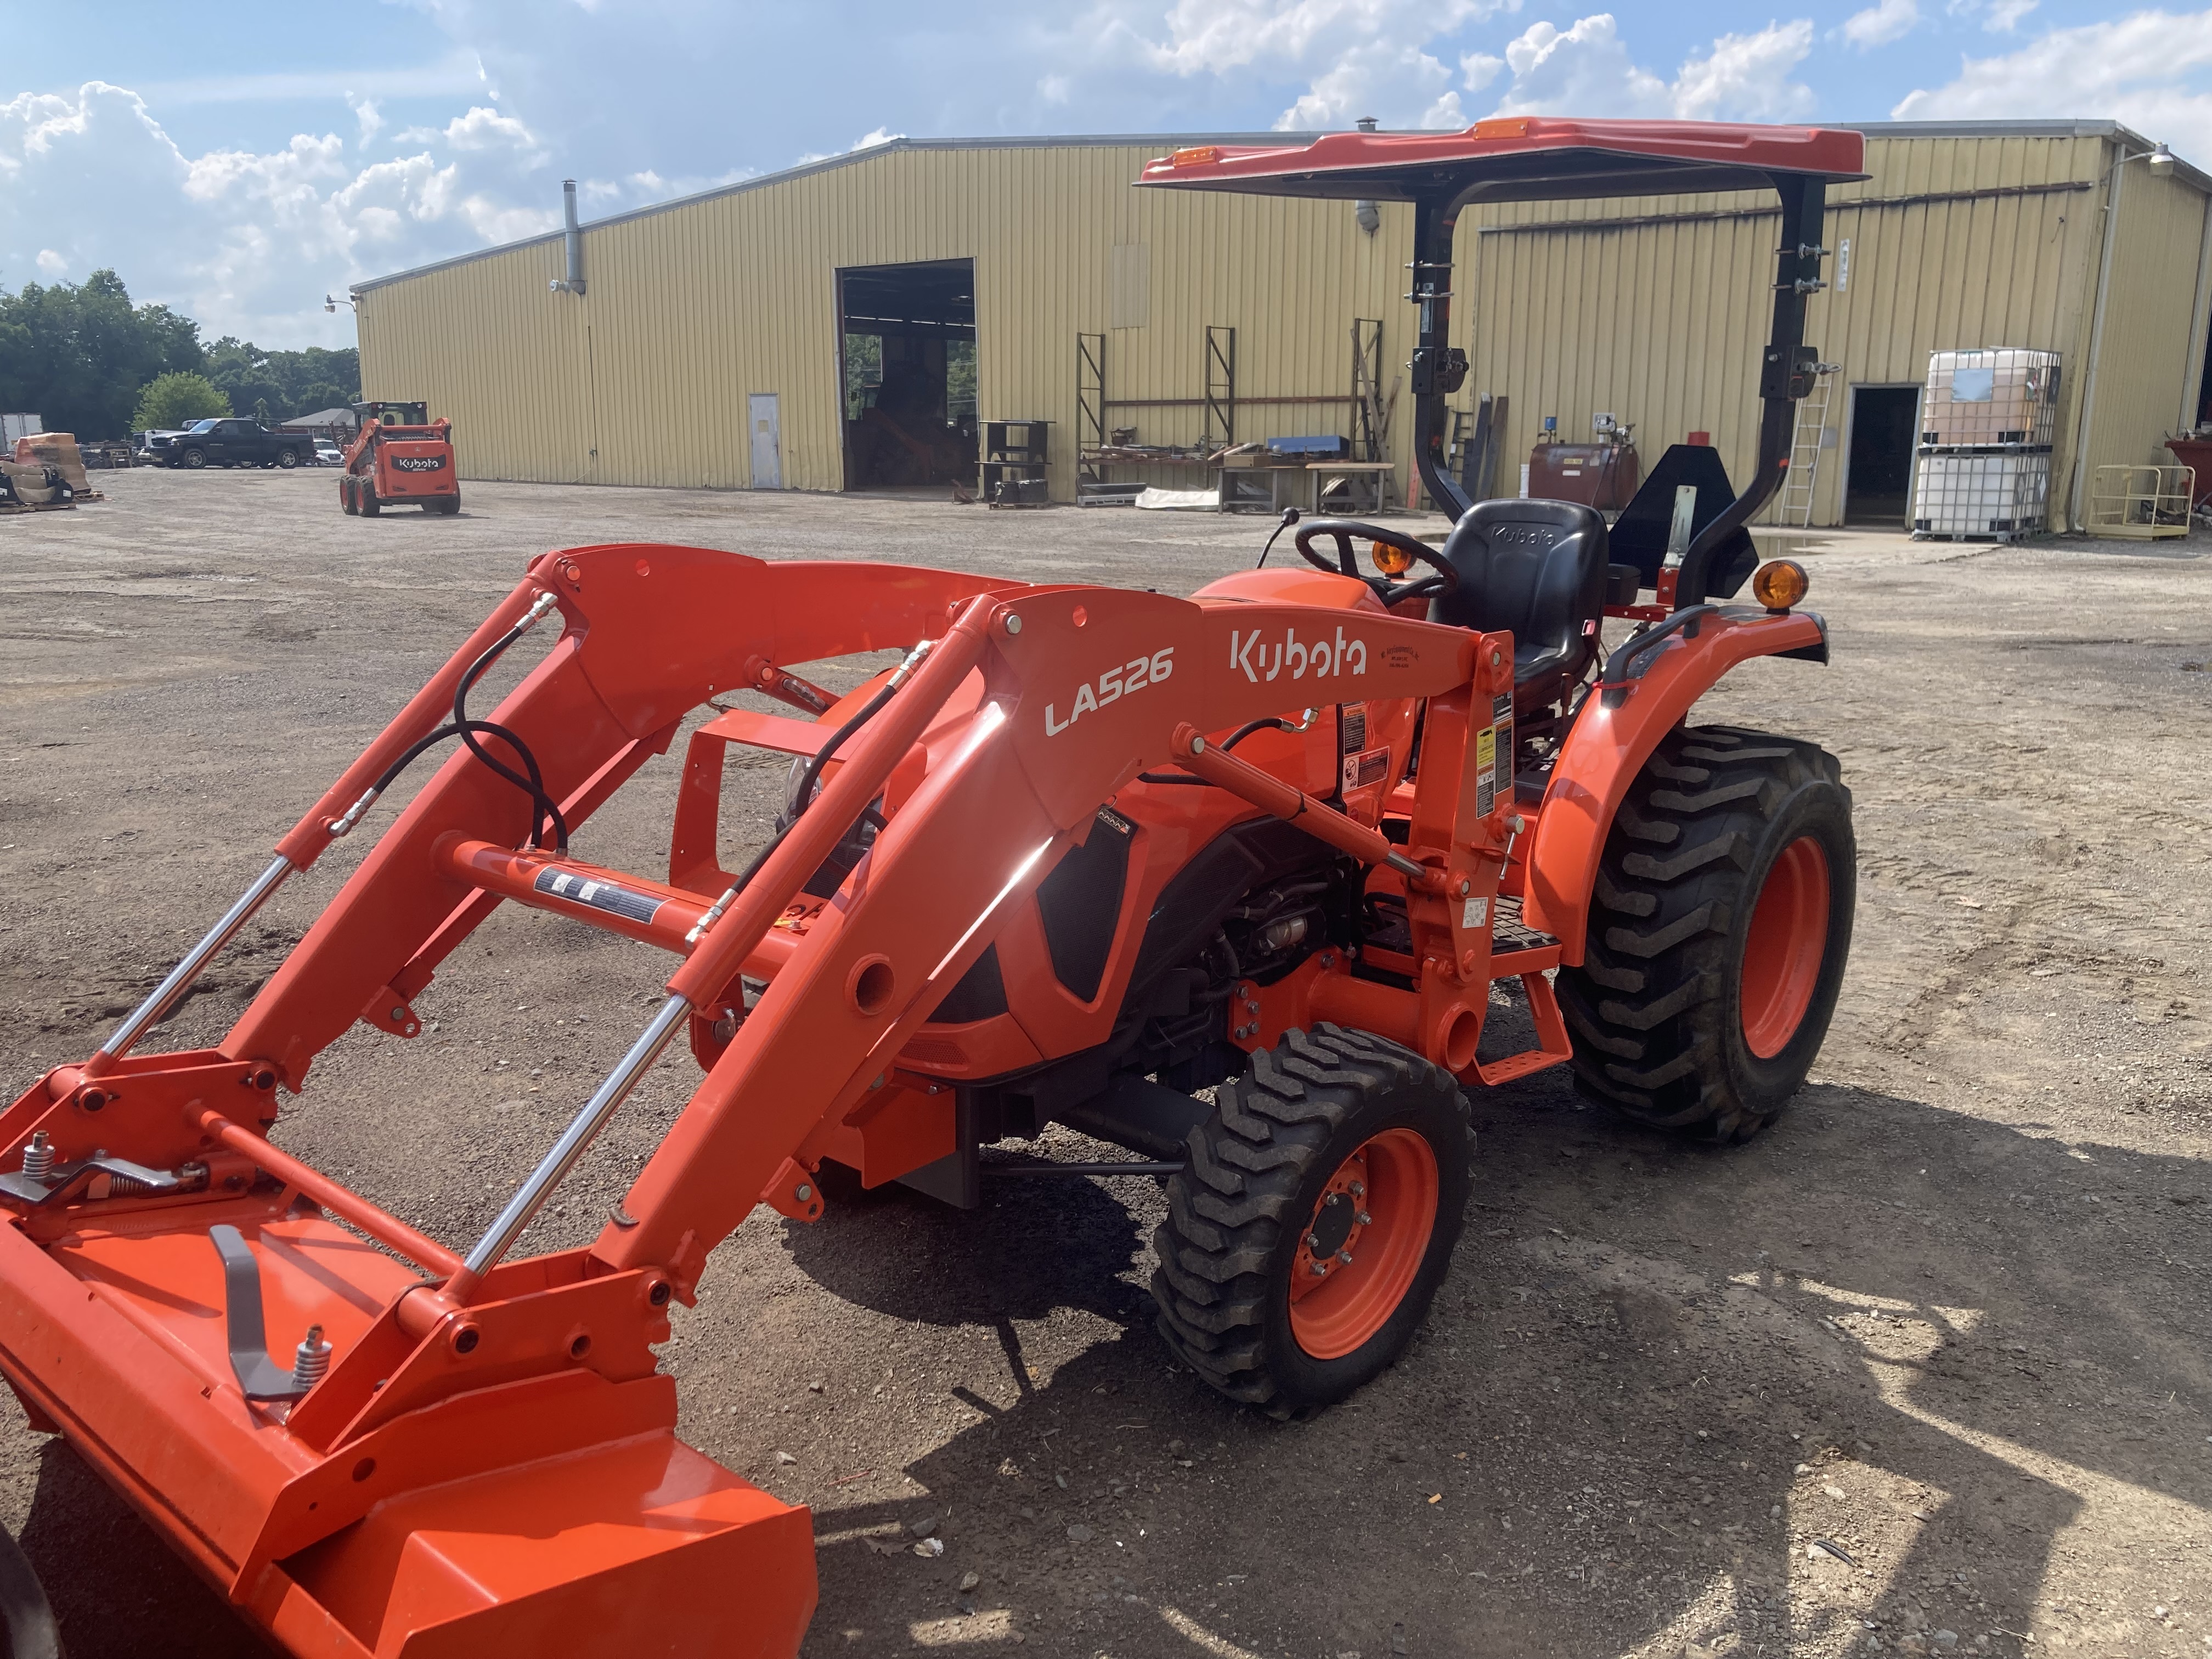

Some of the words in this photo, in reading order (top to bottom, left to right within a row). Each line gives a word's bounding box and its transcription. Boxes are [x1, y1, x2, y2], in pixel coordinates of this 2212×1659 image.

[399, 458, 438, 468] Kubota
[1491, 527, 1555, 546] Kubota
[1230, 626, 1367, 682] Kubota
[1045, 646, 1175, 737] LA526
